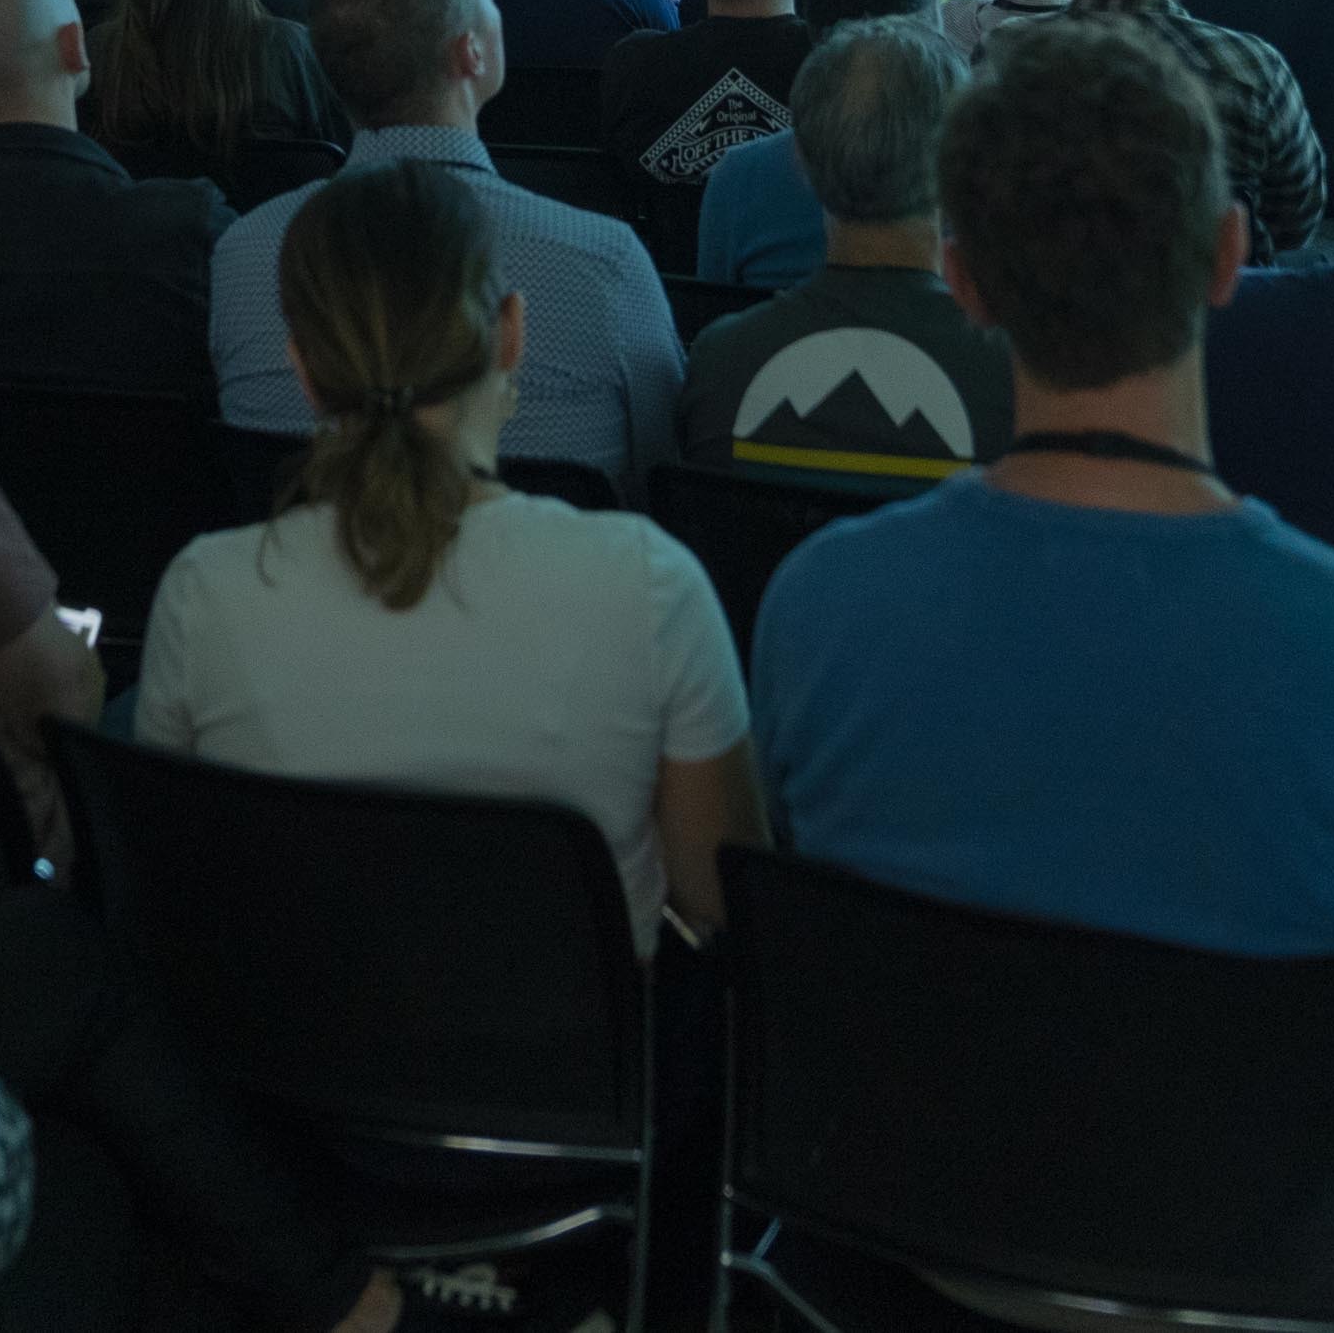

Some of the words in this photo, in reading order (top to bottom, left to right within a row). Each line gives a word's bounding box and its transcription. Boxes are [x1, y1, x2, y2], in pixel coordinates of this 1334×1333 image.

[727, 98, 743, 110] The
[716, 111, 757, 124] Original
[683, 140, 713, 161] OFF
